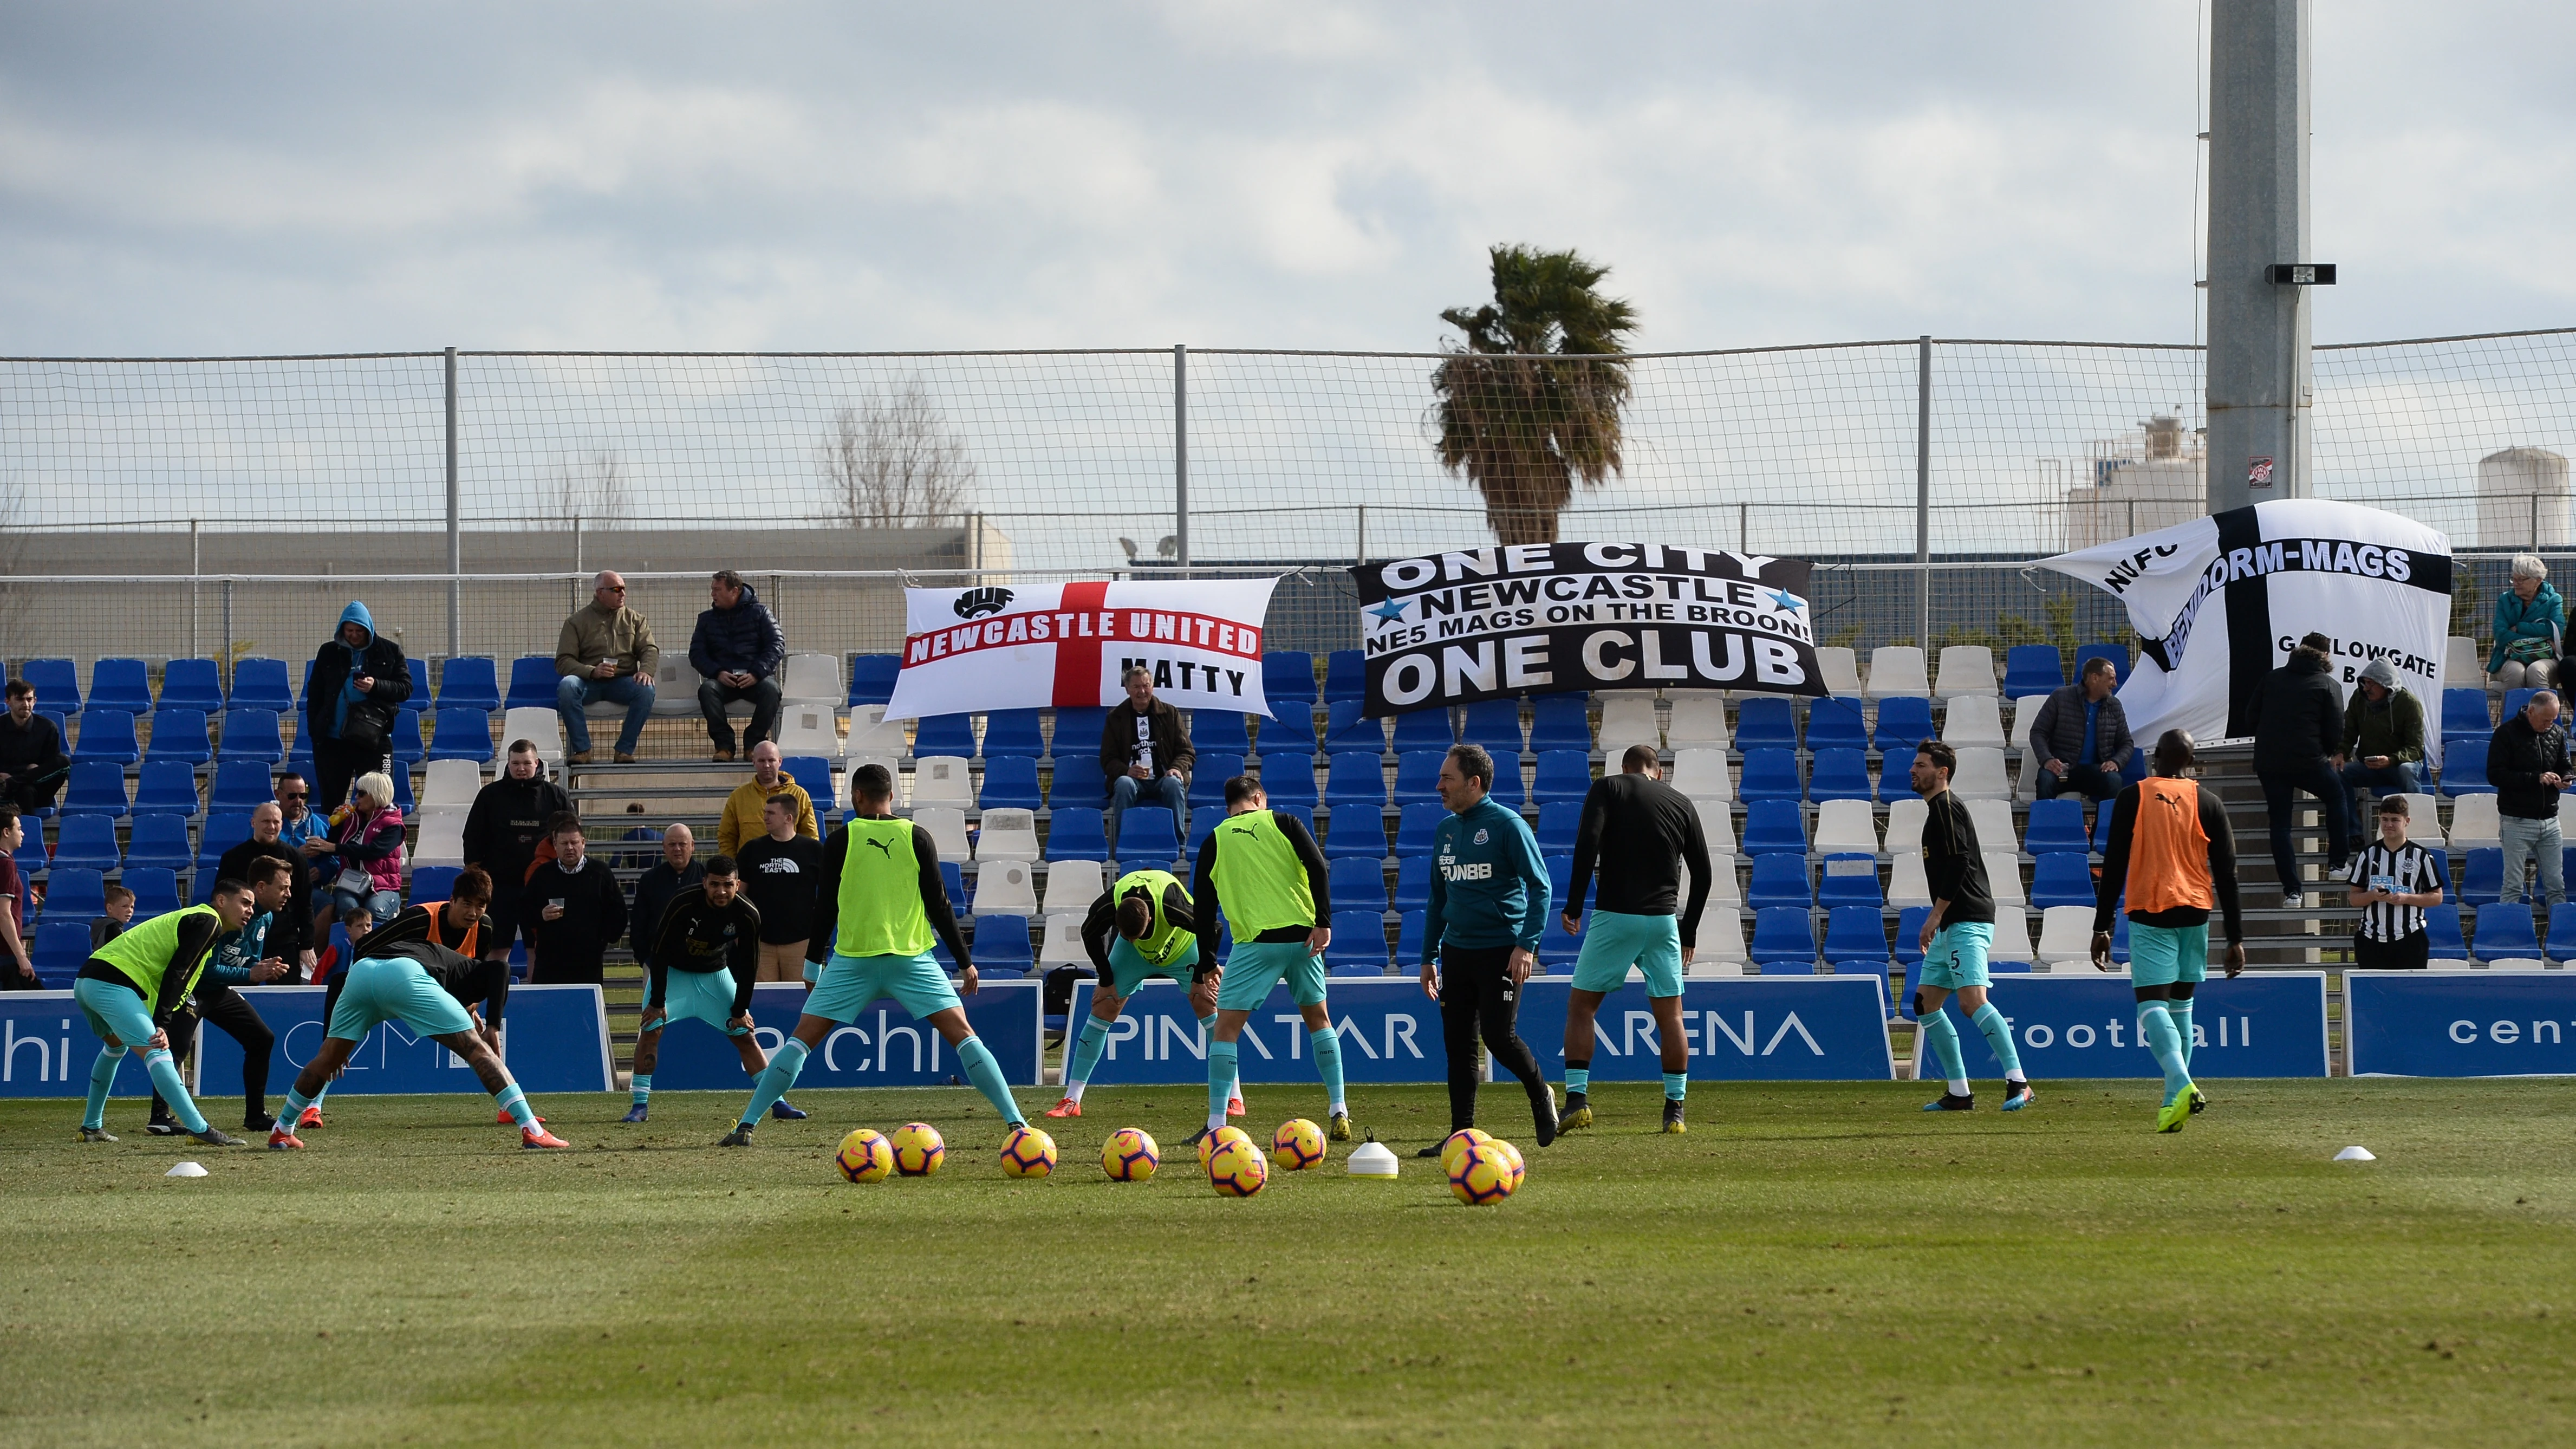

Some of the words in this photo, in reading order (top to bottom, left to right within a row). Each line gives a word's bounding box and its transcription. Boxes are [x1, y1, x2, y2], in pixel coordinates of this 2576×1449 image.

[1381, 543, 1554, 589] ONE
[1584, 542, 1779, 579] CITY
[1420, 575, 1757, 620] NEWCASTLE
[2163, 541, 2410, 668] BENIDORM-MAGS
[910, 612, 1114, 664] NEWCASTLE
[1130, 613, 1257, 654] UNITED
[1367, 625, 1427, 657] NE5
[1439, 609, 1534, 638] MAGS
[1546, 604, 1595, 623] ON
[1606, 603, 1675, 620] THE
[1687, 605, 1810, 642] BROON!
[1382, 634, 1553, 705] ONE
[1582, 630, 1806, 685] CLUB
[2278, 636, 2436, 679] GLOWGATE
[1440, 863, 1492, 881] FUN88
[1951, 950, 1960, 970] 5
[1504, 991, 1513, 1001] AG
[2449, 1015, 2576, 1044] cen
